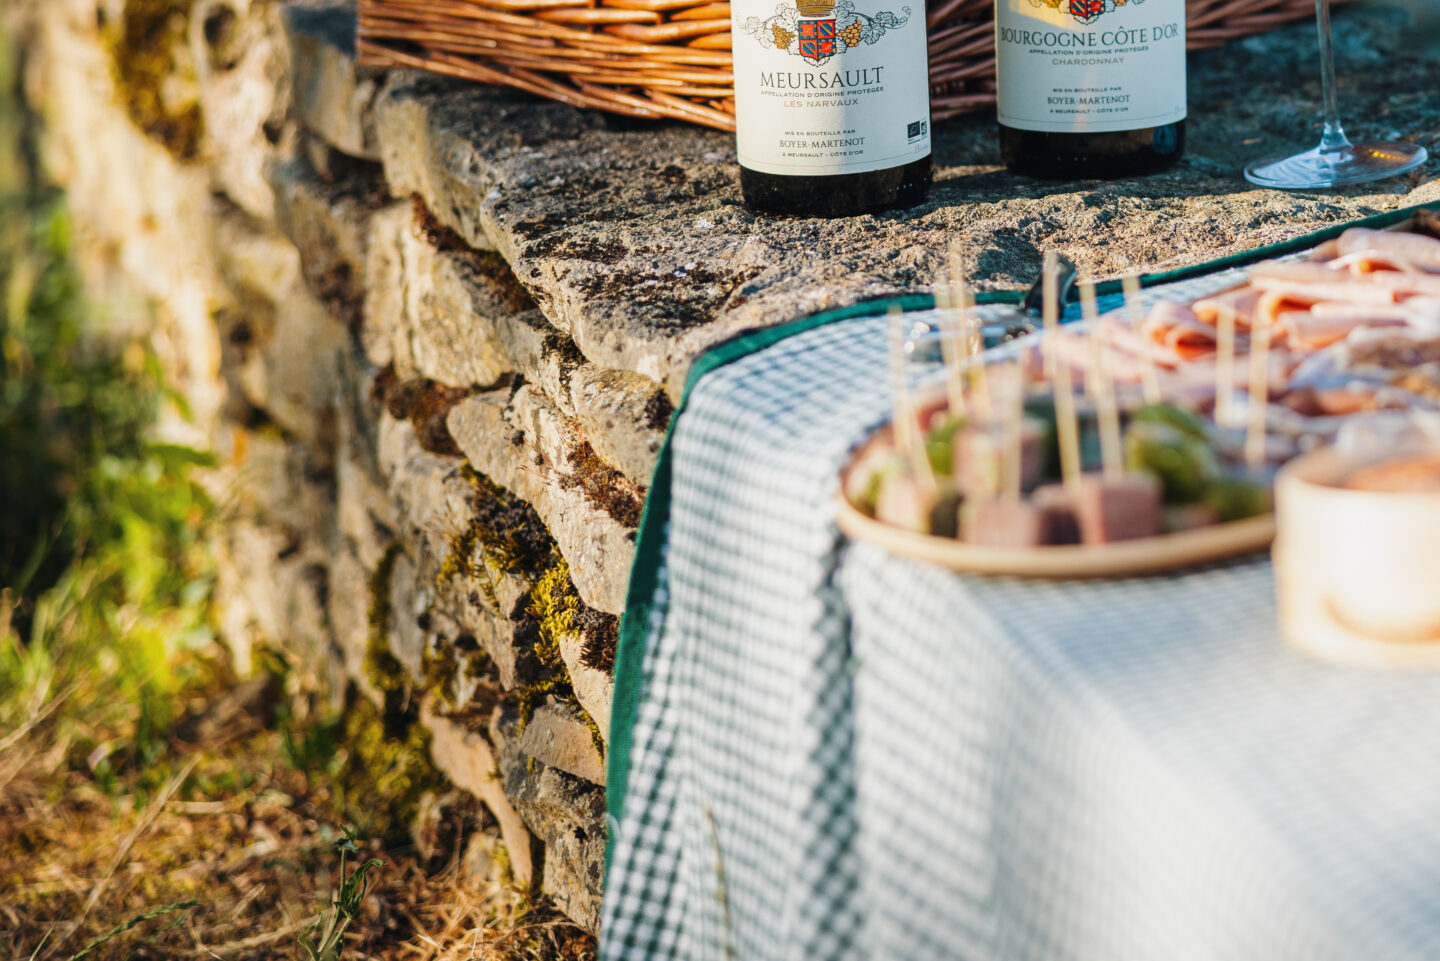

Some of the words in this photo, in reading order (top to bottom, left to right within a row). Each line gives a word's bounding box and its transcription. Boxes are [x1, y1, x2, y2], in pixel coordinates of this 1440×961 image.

[1001, 27, 1096, 47] BOURGOGNE
[1102, 26, 1147, 46] CÔTE
[1153, 23, 1178, 41] D'OR
[1052, 57, 1125, 65] CHARDONNAY
[760, 66, 884, 88] MEURSAULT
[806, 99, 858, 107] NARVAUX
[1047, 95, 1131, 105] BOYER-MARTENOT
[779, 137, 866, 148] BOYER-MARTENOT
